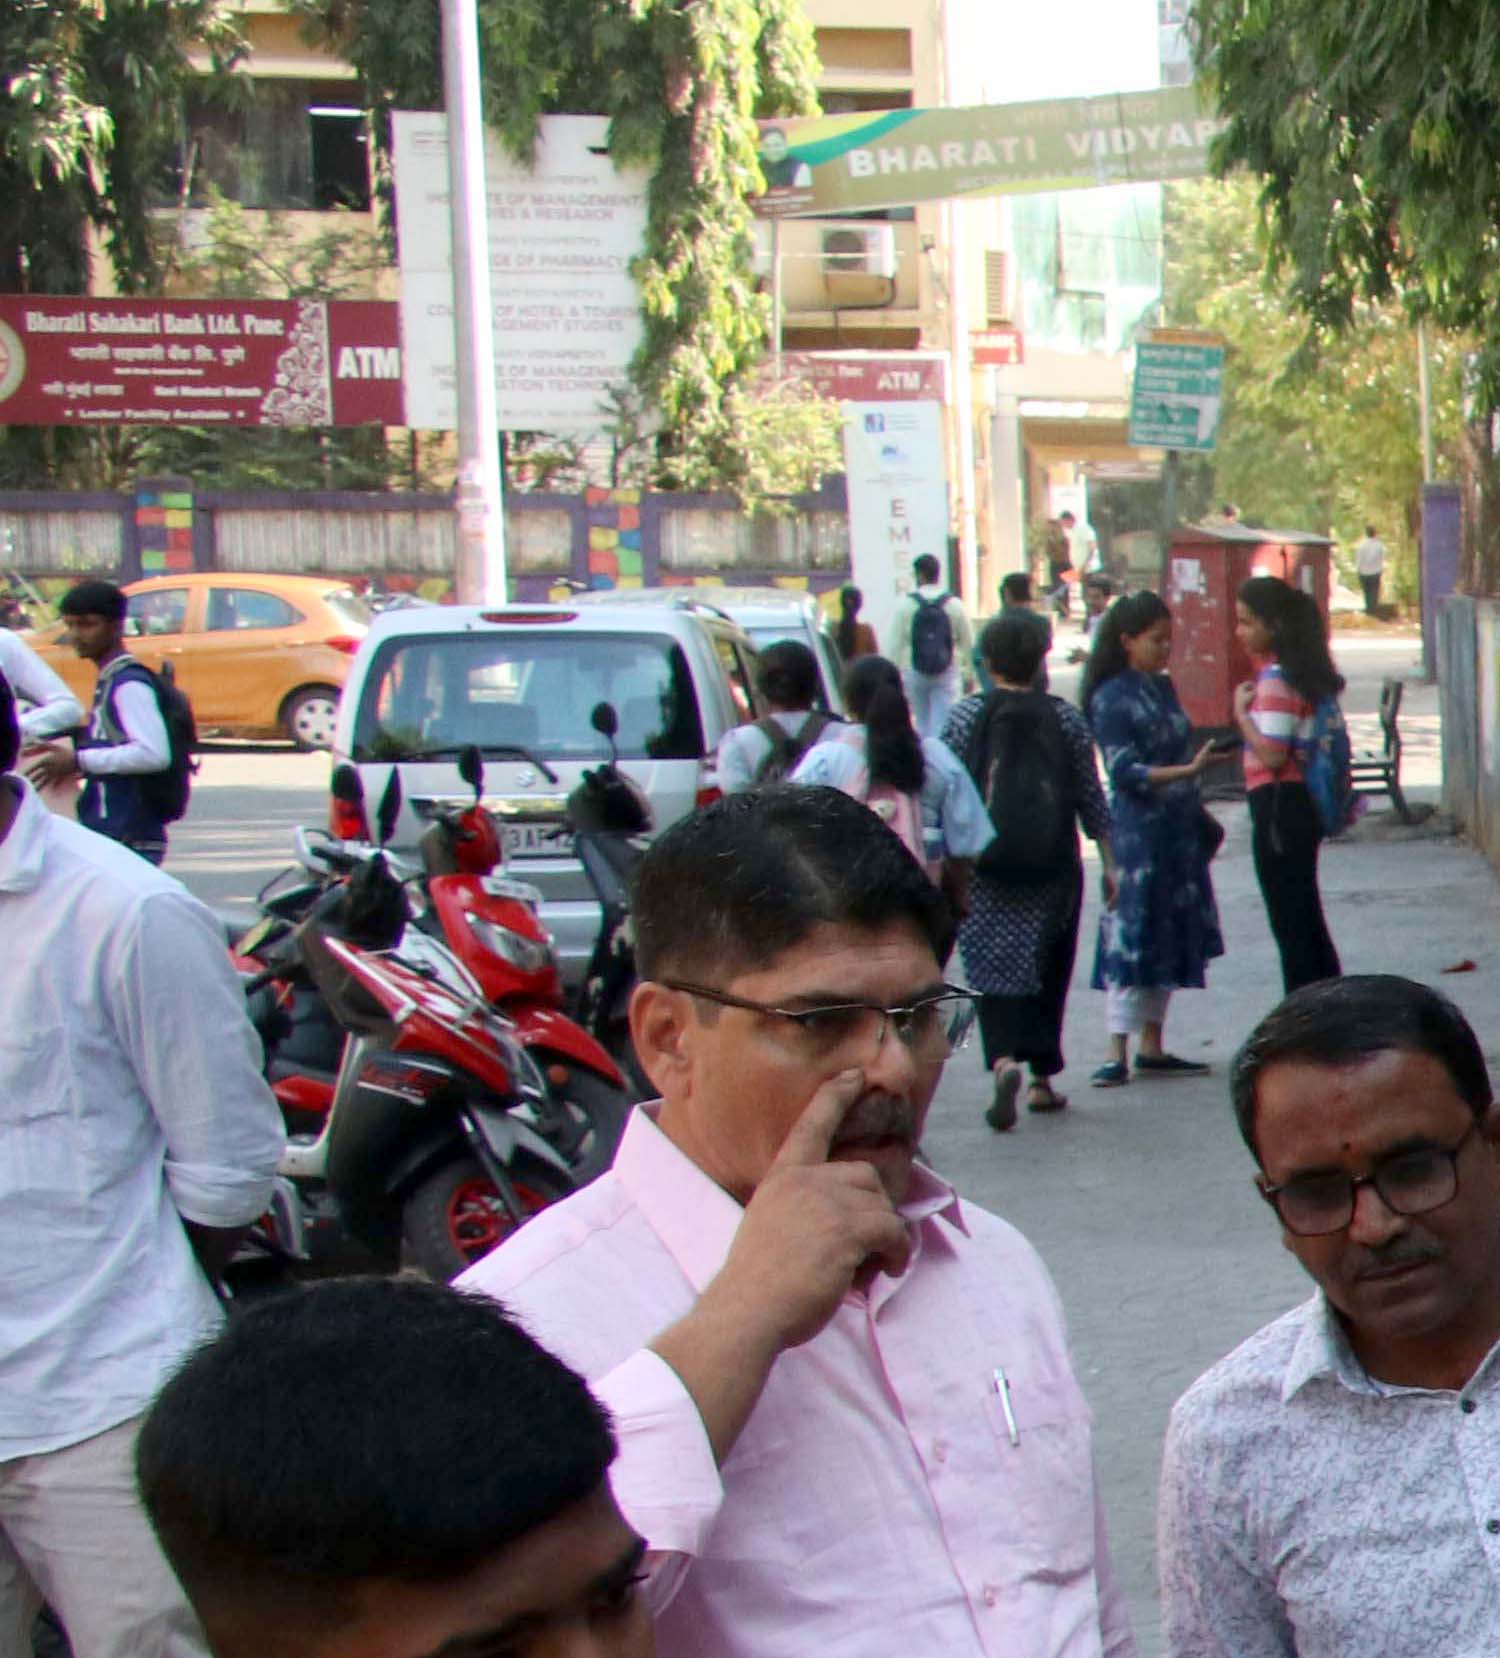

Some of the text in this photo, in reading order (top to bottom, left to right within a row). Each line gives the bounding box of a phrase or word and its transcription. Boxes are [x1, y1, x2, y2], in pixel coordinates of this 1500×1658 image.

[848, 136, 1036, 178] BHARATI
[25, 311, 86, 333] Bharati
[163, 312, 206, 334] Bank
[208, 313, 241, 335] Ltd.
[244, 314, 284, 336] Pune
[337, 346, 400, 379] ATM
[877, 371, 921, 391] ATM
